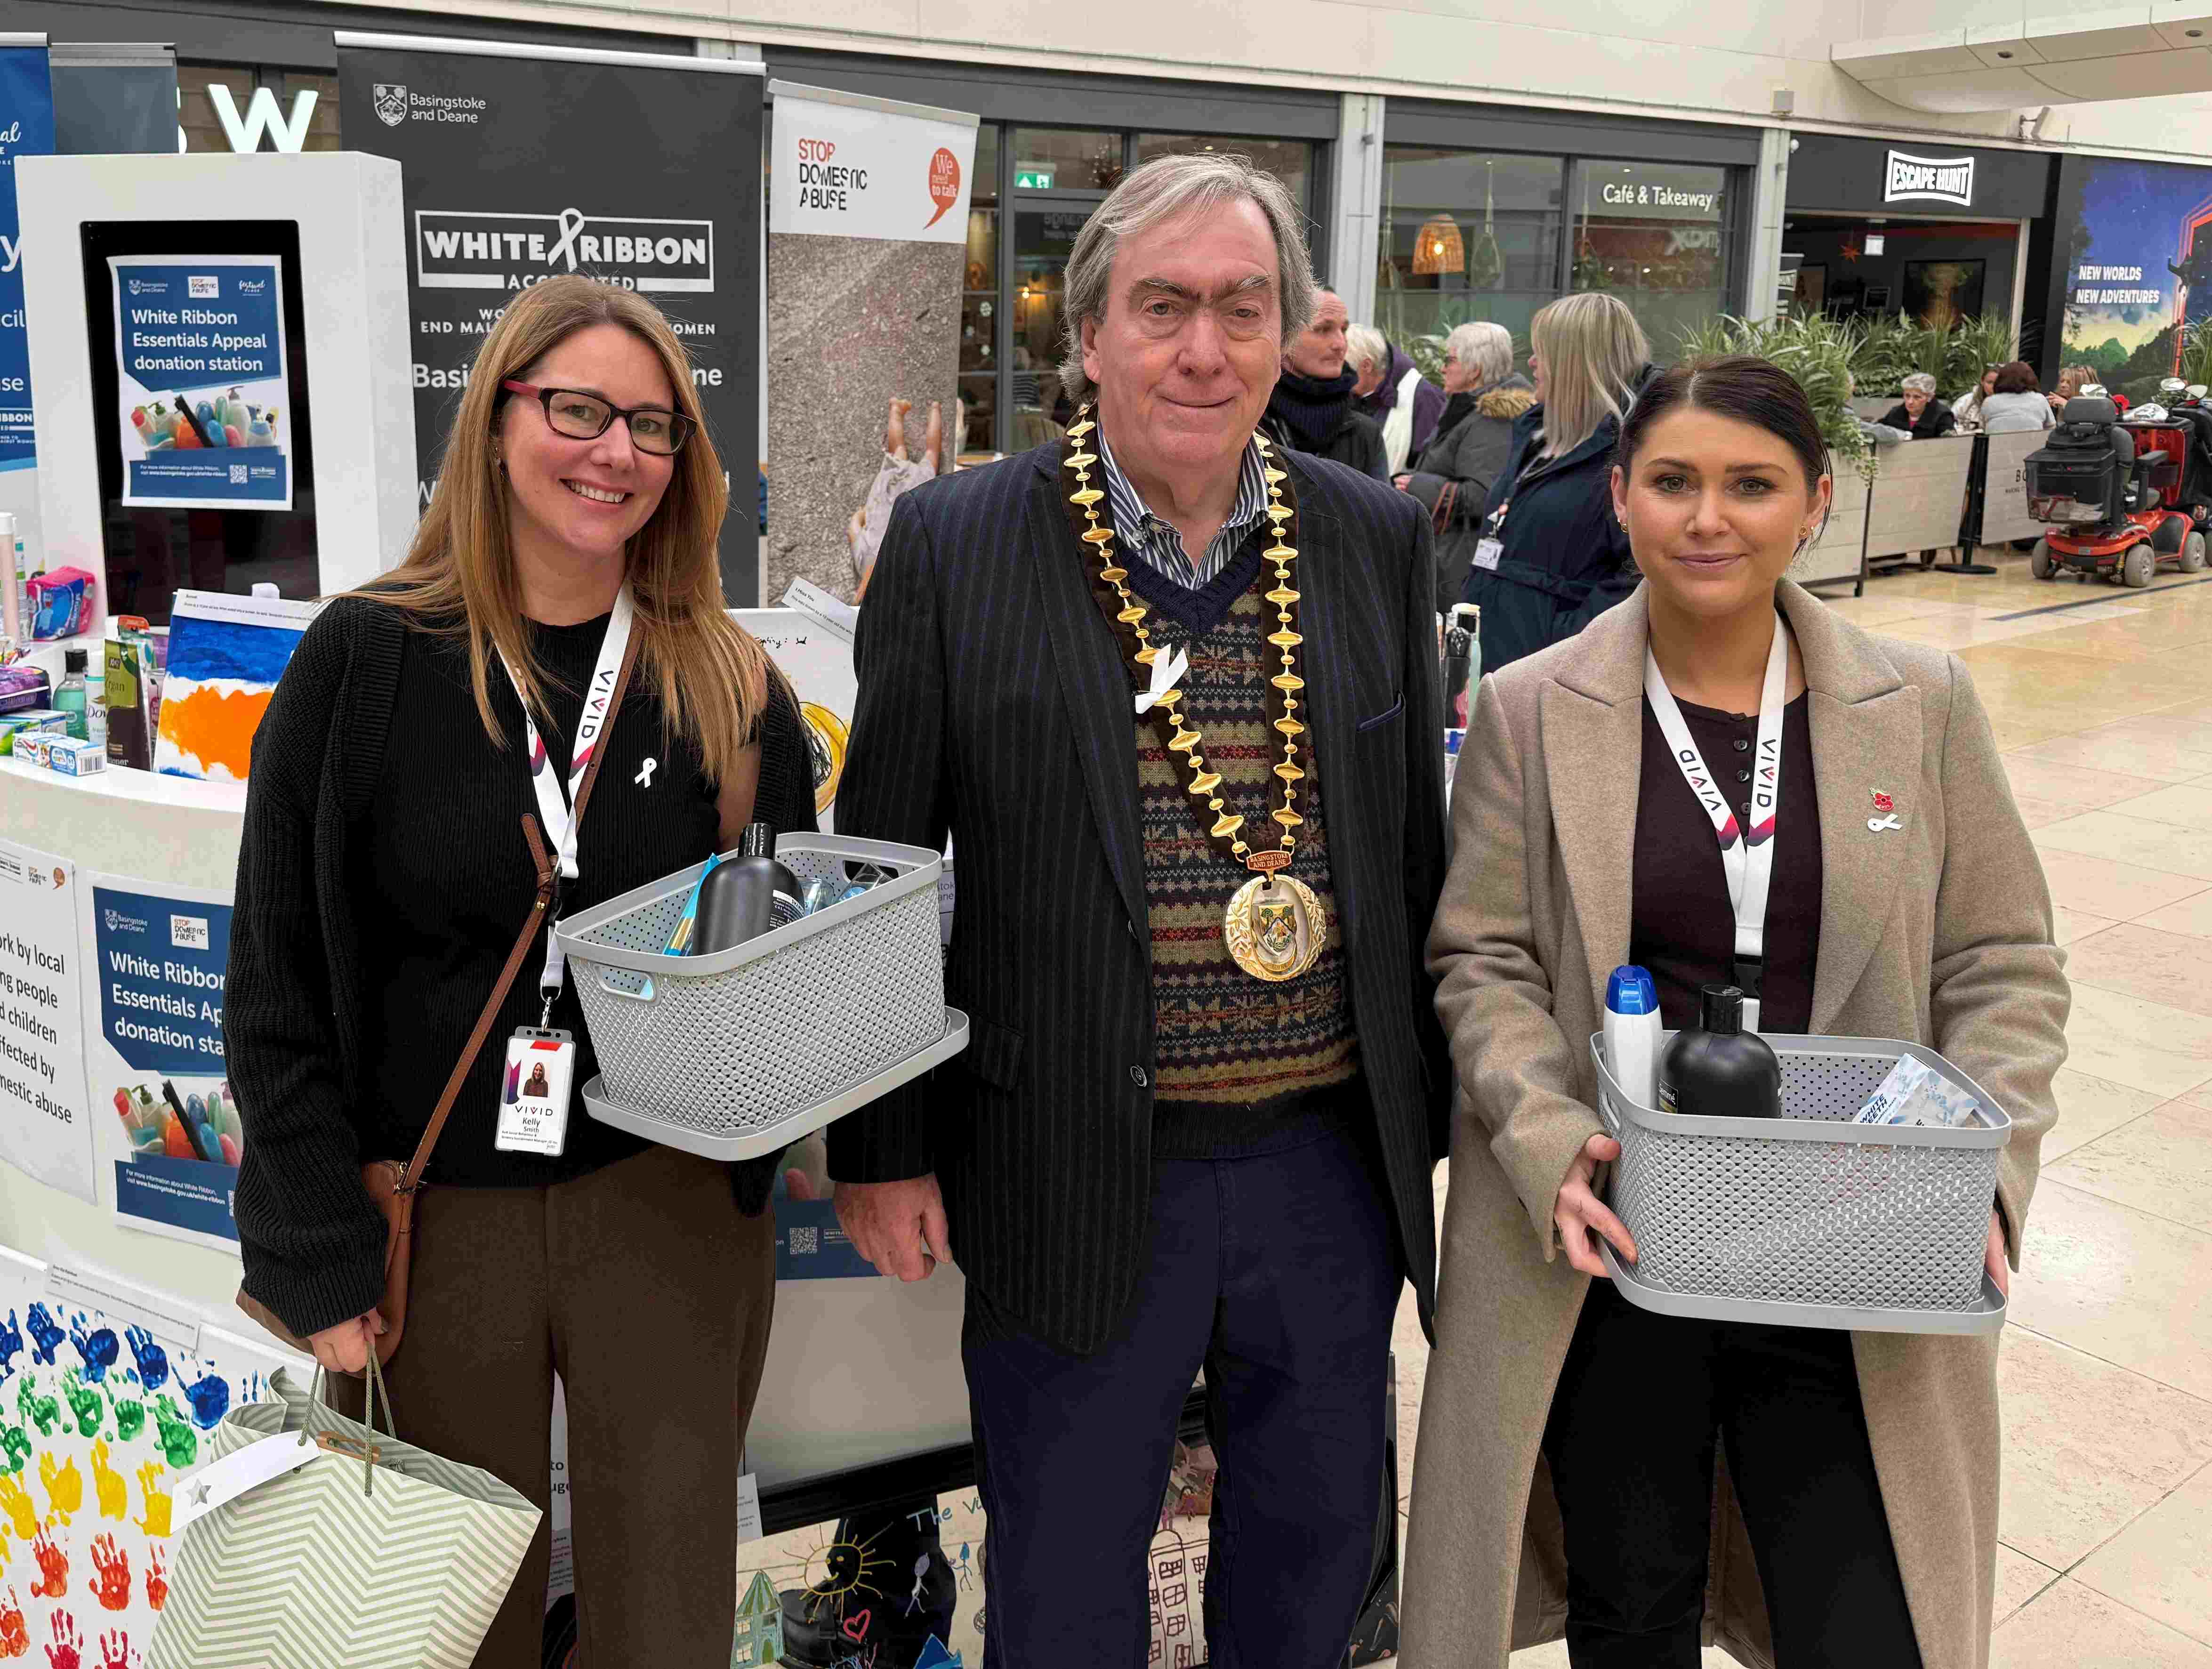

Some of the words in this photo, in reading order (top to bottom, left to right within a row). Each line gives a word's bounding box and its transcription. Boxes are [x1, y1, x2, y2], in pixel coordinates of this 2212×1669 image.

[410, 93, 486, 110] Basingstoke
[411, 109, 434, 121] and
[437, 109, 478, 123] Deane
[799, 138, 836, 162] STOP
[800, 163, 867, 190] DOMESTIC
[936, 153, 953, 175] We
[1891, 161, 1937, 191] ESCAPE
[1936, 167, 1969, 194] HUNT
[800, 187, 846, 211] ABUSE
[932, 185, 941, 196] to
[942, 184, 957, 197] talk
[1603, 184, 1634, 203] Café
[1637, 185, 1649, 204] &
[1651, 186, 1713, 212] Takeaway
[424, 231, 547, 262] WHITE
[580, 235, 706, 265] RIBBON
[2079, 265, 2102, 281] NEW
[2103, 266, 2142, 281] WORLDS
[2076, 288, 2099, 304] NEW
[2100, 289, 2159, 304] ADVENTURES
[132, 309, 177, 324] White
[182, 309, 238, 325] Ribbon
[421, 321, 453, 333] END
[133, 332, 208, 347] Essentials
[212, 332, 267, 351] Appeal
[135, 355, 205, 371] donation
[209, 356, 263, 371] station
[0, 413, 32, 422] BBON
[581, 670, 614, 739] VIVID
[1679, 750, 1721, 811] VIVID
[1757, 739, 1776, 807] VIVID
[1250, 854, 1288, 862] BASINGSTOKE
[17, 936, 31, 966] by
[34, 944, 64, 975] local
[110, 951, 160, 979] White
[16, 978, 57, 1008] people
[113, 984, 196, 1018] Essentials
[8, 1007, 56, 1045] children
[114, 1016, 194, 1050] donation
[40, 1055, 54, 1084] by
[35, 1092, 72, 1123] abuse
[515, 1105, 553, 1116] VIVID
[1860, 1093, 1884, 1123] WHITE
[1867, 1098, 1887, 1123] EETH
[523, 1117, 540, 1127] Kelly
[906, 1507, 952, 1532] The
